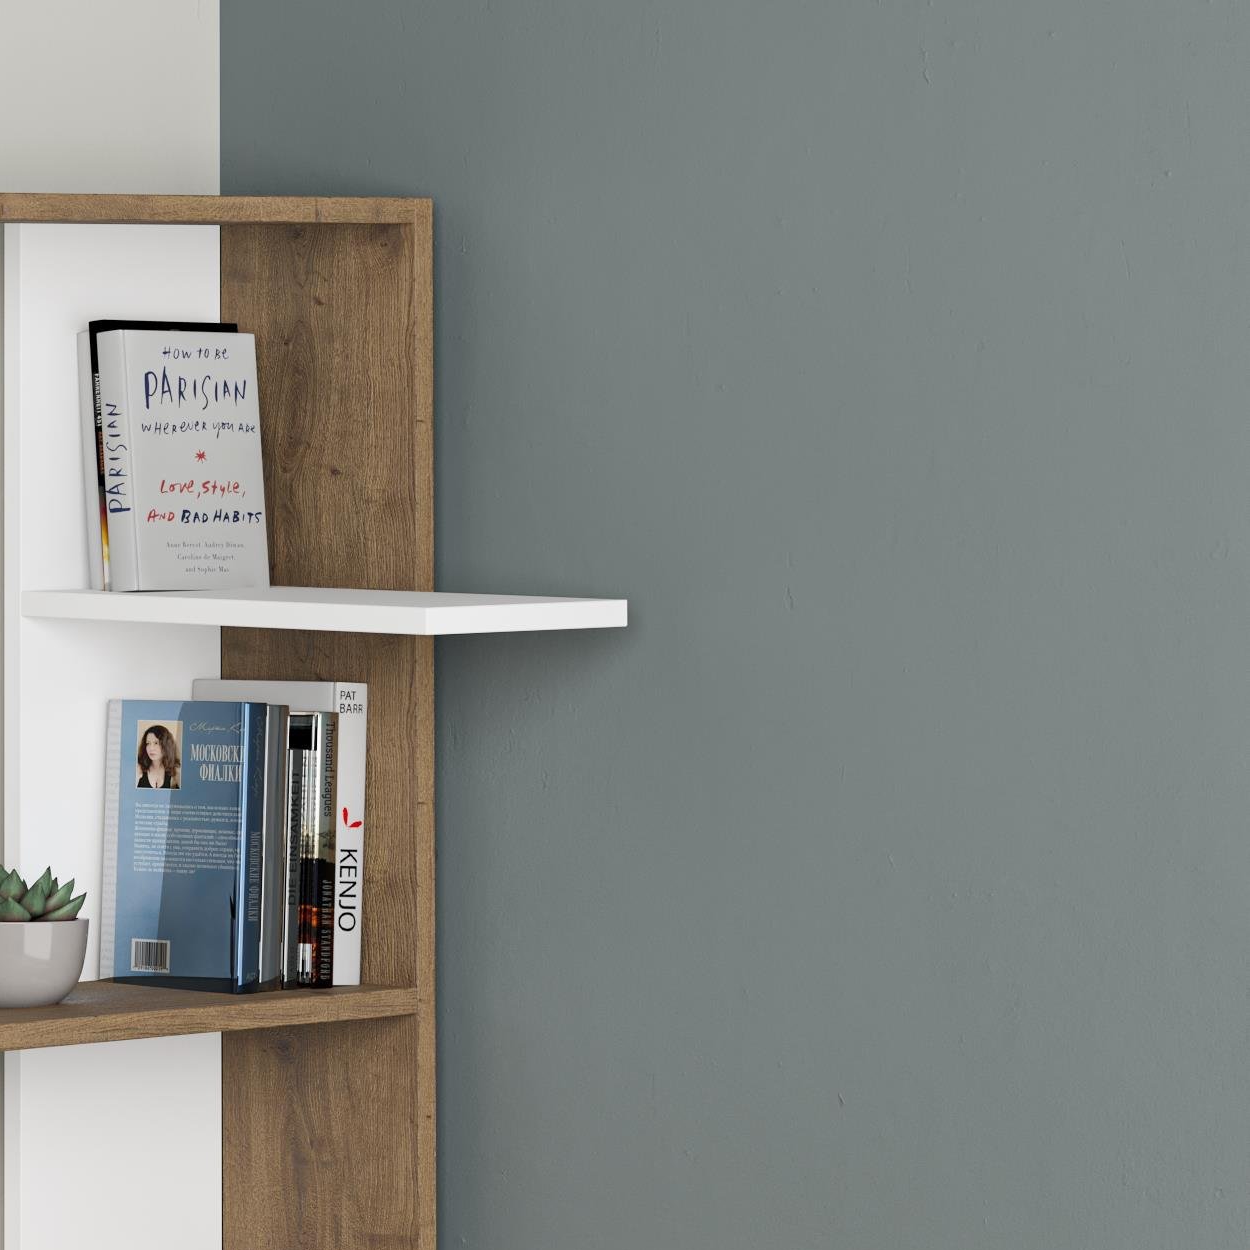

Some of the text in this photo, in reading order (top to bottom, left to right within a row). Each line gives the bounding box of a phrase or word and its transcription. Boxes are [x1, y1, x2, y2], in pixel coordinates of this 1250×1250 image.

[144, 365, 247, 410] PARISIAN
[104, 403, 131, 513] PARISIAN
[160, 479, 201, 499] Love,
[181, 509, 209, 524] BAD
[213, 508, 263, 524] HABITS
[339, 703, 363, 714] BARR
[340, 690, 356, 701] PAT
[199, 763, 243, 782] ФИАЛКИ
[321, 721, 335, 817] Thousand Leagues
[288, 772, 300, 906] DIE EINSAMKEIT
[338, 848, 358, 932] KENJO
